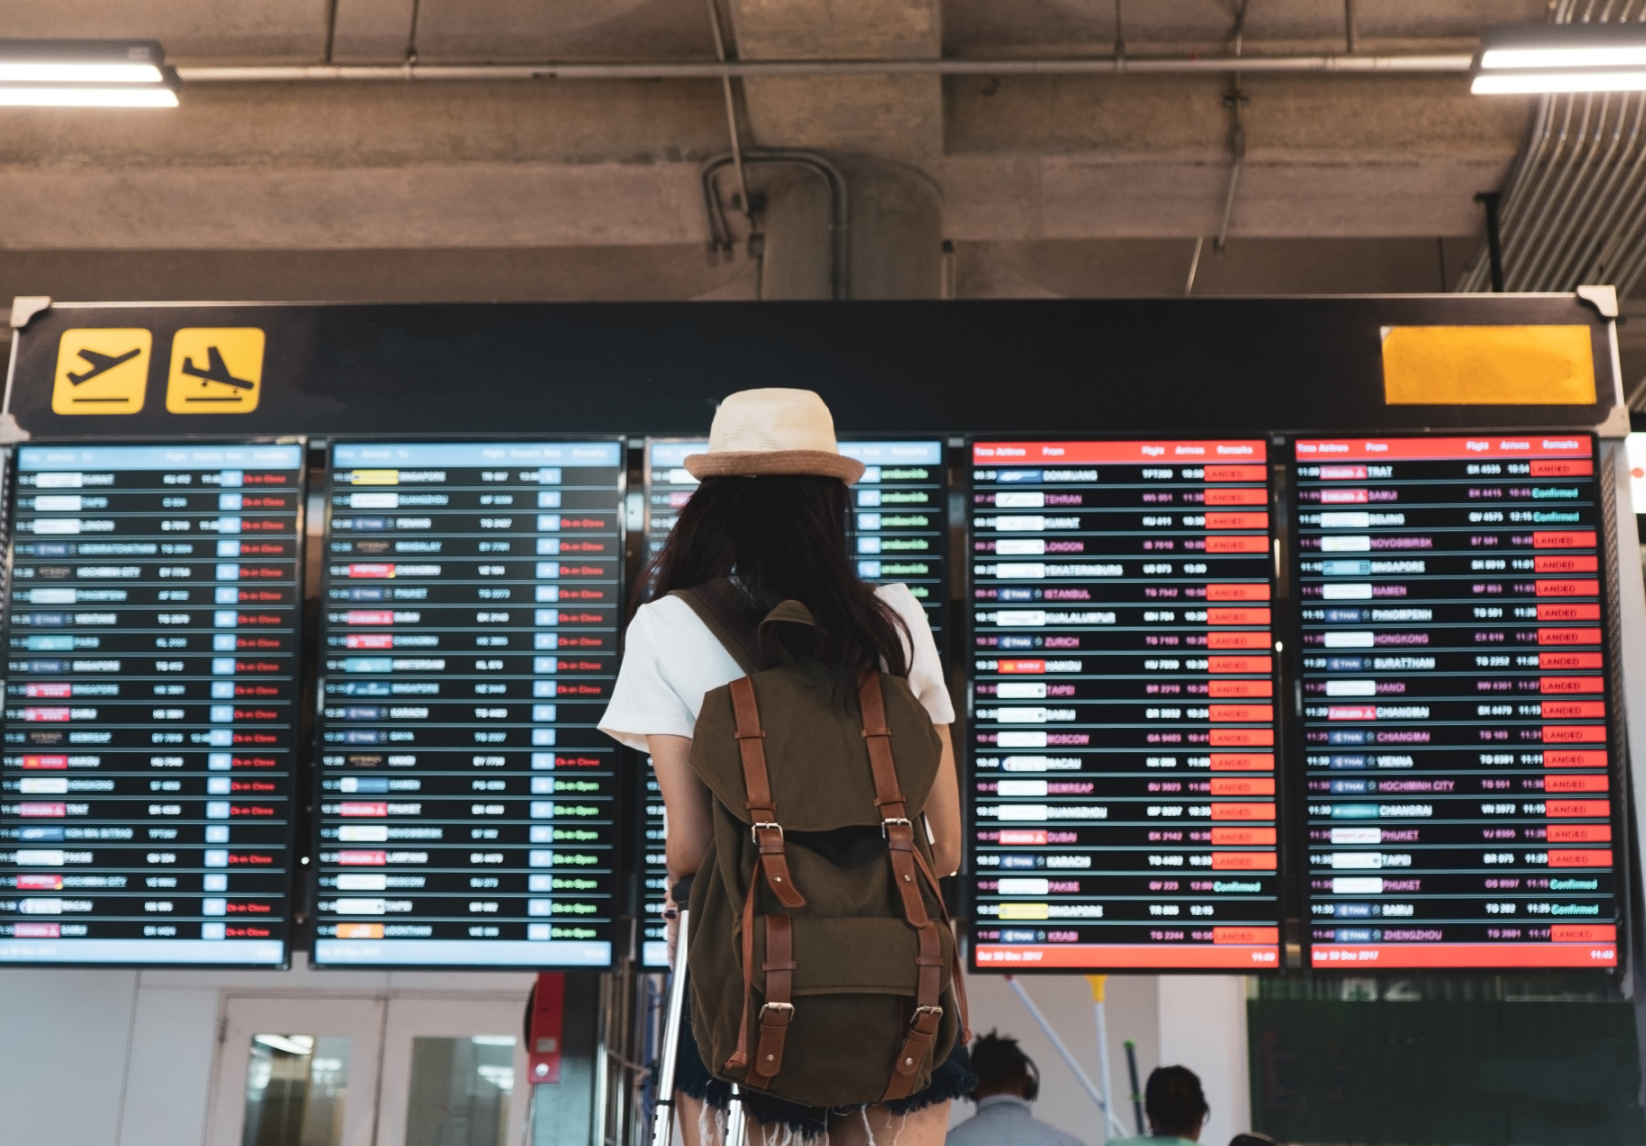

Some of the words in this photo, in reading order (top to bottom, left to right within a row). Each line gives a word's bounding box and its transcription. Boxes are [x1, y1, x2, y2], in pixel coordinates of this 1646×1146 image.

[1366, 443, 1388, 451] From
[1466, 441, 1489, 451] Flight
[1542, 440, 1578, 449] Remarks
[1042, 447, 1064, 456] From
[1142, 446, 1164, 456] Flight
[1217, 446, 1253, 454] Remarks
[1367, 466, 1392, 477] TRAT
[264, 474, 286, 483] Close
[1532, 488, 1578, 498] Confirmed
[1045, 495, 1082, 504] TEHRAN
[1533, 512, 1579, 522] Confirmed
[1045, 542, 1084, 551] LONDON
[1370, 538, 1432, 548] NOVOSIBIRSK
[261, 544, 284, 553] Close
[1371, 561, 1425, 572] SINGAPORE
[1045, 590, 1090, 598] ISTANBUL
[1372, 586, 1406, 595] XIAMEN
[258, 615, 281, 624] Close
[1339, 610, 1358, 618] THAI
[1372, 609, 1432, 620] PHNOMPENH
[1045, 638, 1079, 647] ZURICH
[1375, 634, 1428, 644] HONGKONG
[256, 662, 279, 671] Close
[1341, 660, 1359, 668] THAI
[1374, 658, 1435, 669] SURATTHANI
[1047, 686, 1075, 695] TAIPEI
[1376, 683, 1405, 692] HANOI
[255, 710, 277, 718] Close
[1376, 707, 1429, 718] CHIANGMAI
[1047, 735, 1089, 744] MOSCOW
[1343, 734, 1362, 742] THAI
[1377, 732, 1430, 741] CHIANGMAI
[253, 758, 276, 766] Close
[1344, 758, 1363, 766] THAI
[1377, 756, 1413, 767] VIENNA
[1345, 781, 1364, 789] THAI
[1379, 782, 1431, 790] HOCHIMINH
[1433, 781, 1454, 790] CITY
[251, 806, 274, 815] Close
[1380, 805, 1432, 816] CHIANGRAI
[1048, 832, 1077, 842] DUBAI
[1381, 830, 1418, 840] PHUKET
[250, 854, 272, 863] Close
[1382, 854, 1411, 866] TAIPEI
[1048, 882, 1080, 892] PAKSE
[1213, 882, 1261, 892] Confirmed
[1383, 880, 1420, 890] PHUKET
[1550, 880, 1597, 889] Confirmed
[1350, 906, 1368, 914] THAI
[1551, 904, 1598, 914] Confirmed
[247, 928, 270, 936] Close
[1048, 932, 1078, 942] KRABI
[1351, 932, 1369, 940] THAI
[1383, 930, 1442, 940] ZHENGZHOU
[978, 951, 992, 961] Sat
[1313, 951, 1327, 960] Sat
[1359, 951, 1378, 960] 2017
